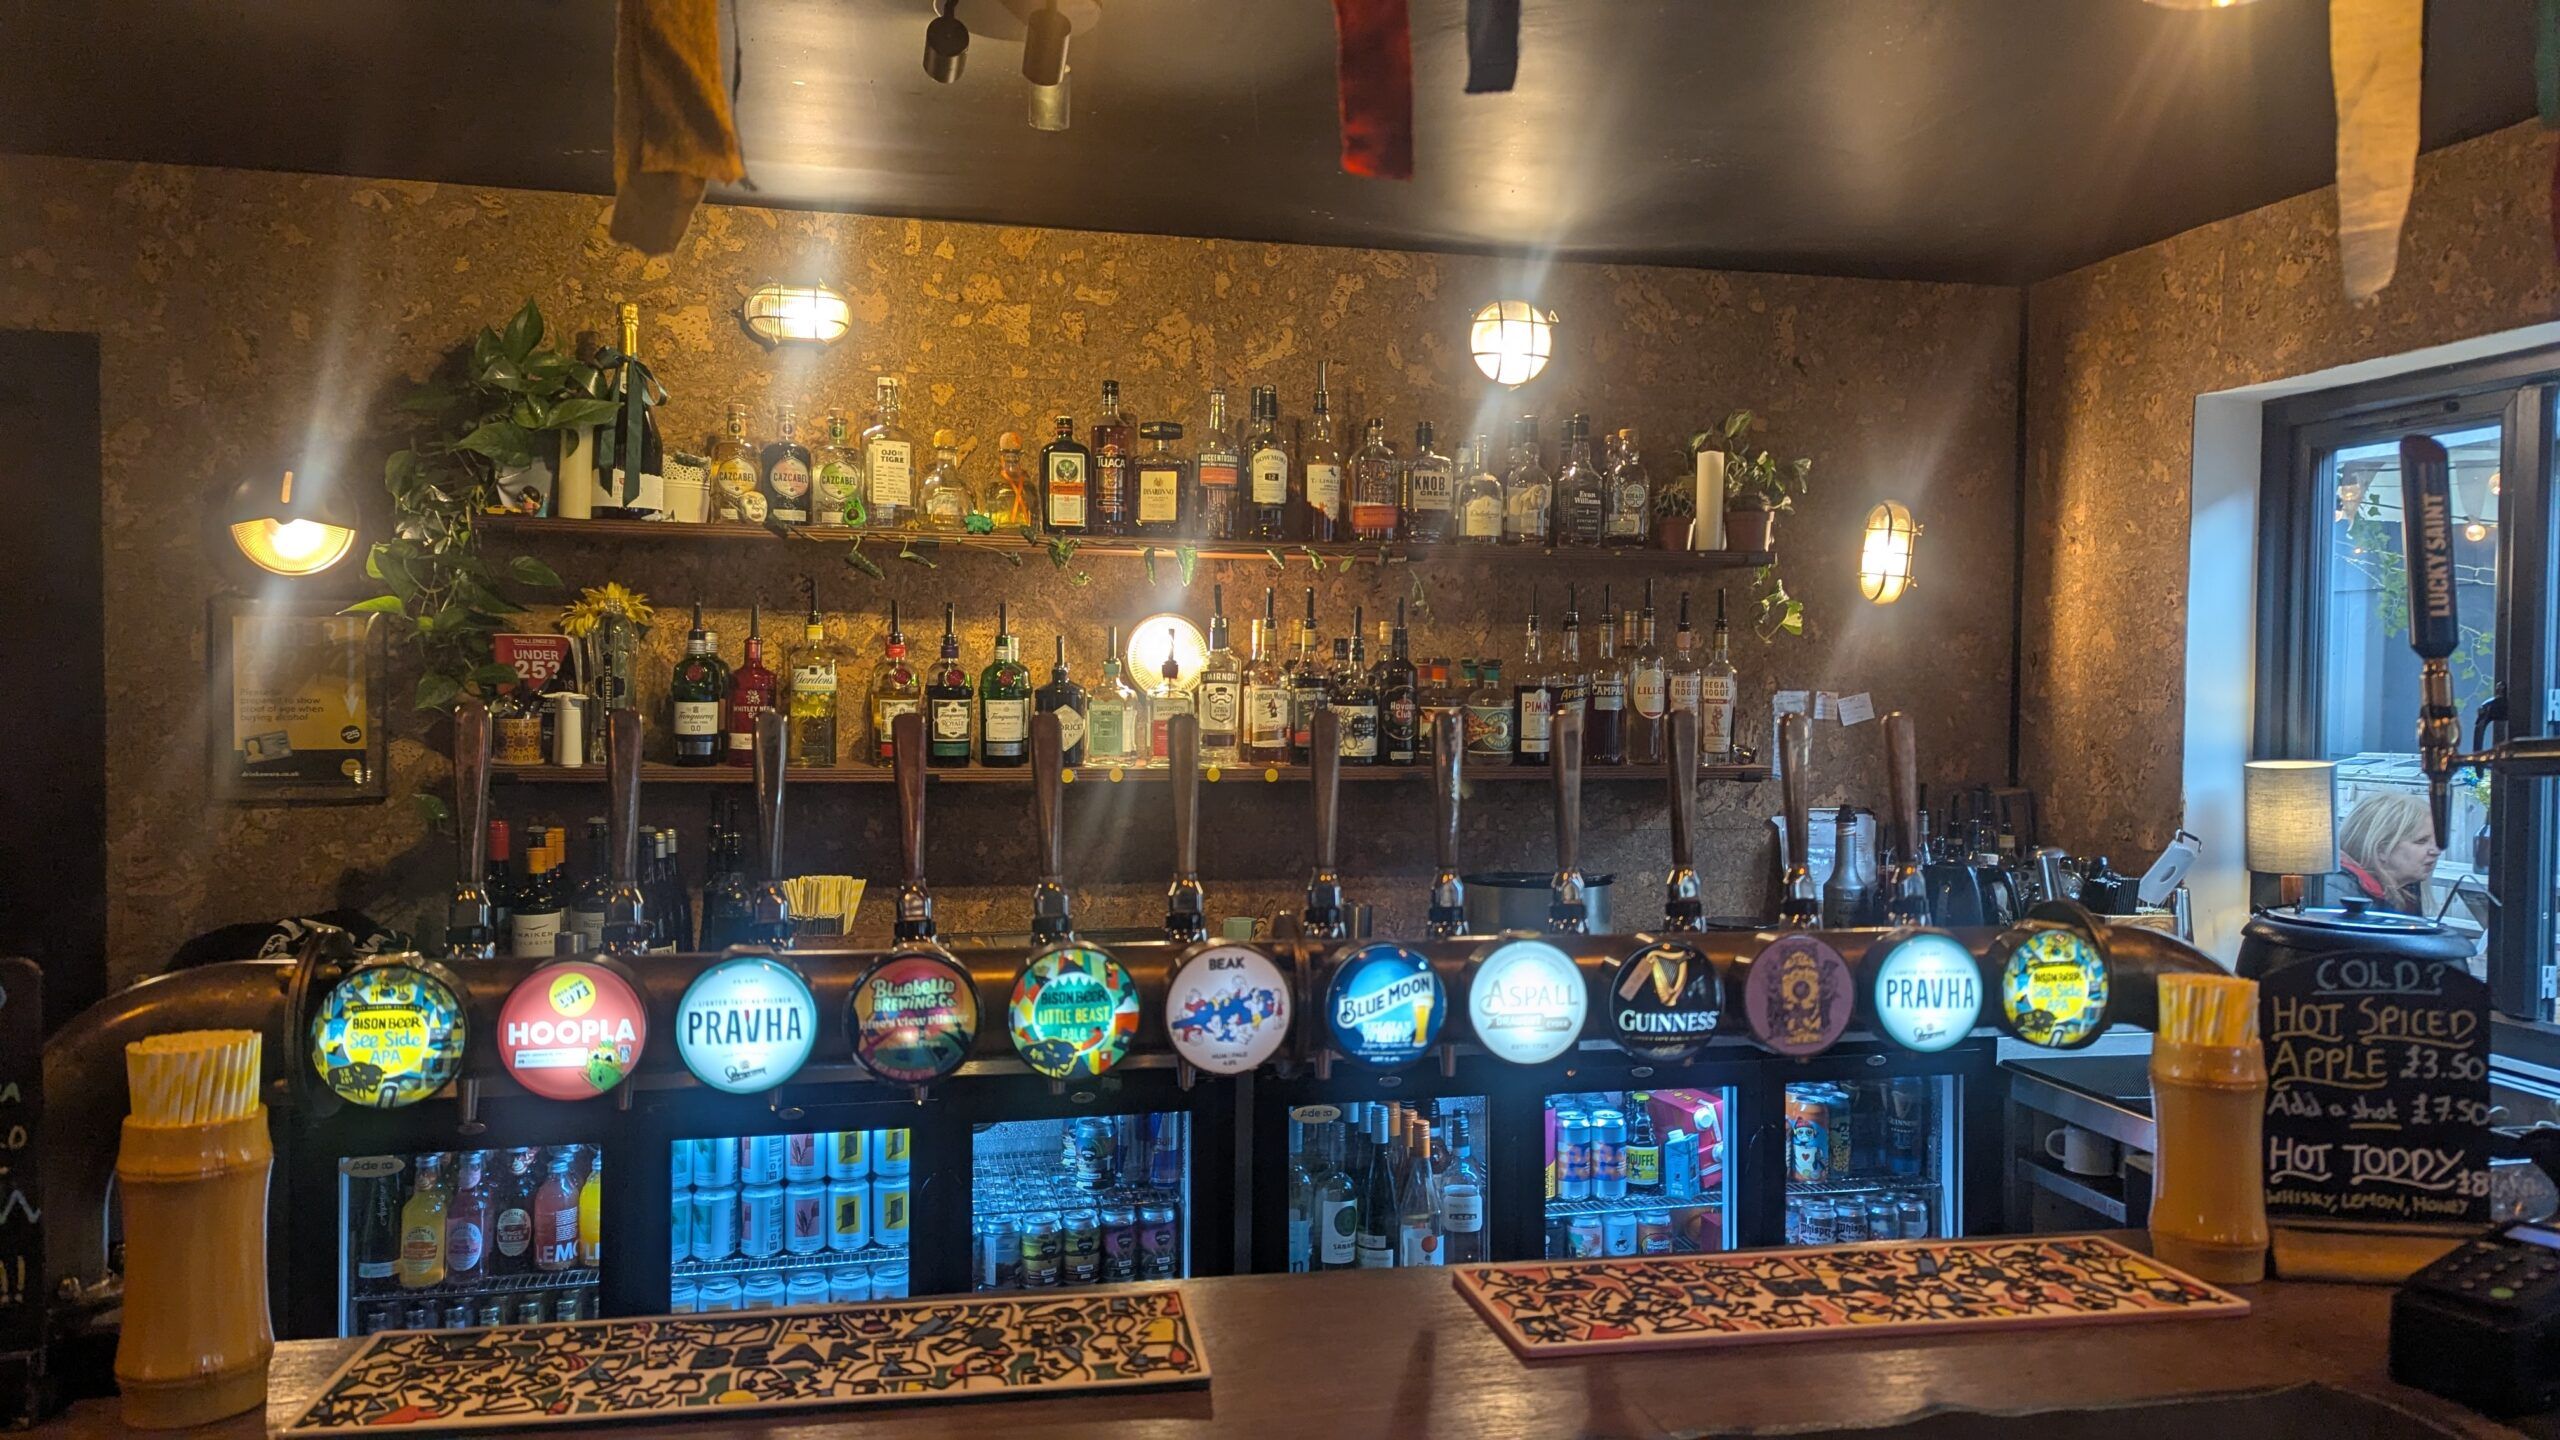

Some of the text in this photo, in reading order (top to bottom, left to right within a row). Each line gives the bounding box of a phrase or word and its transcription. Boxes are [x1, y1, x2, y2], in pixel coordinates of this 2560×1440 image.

[1096, 456, 1126, 468] TUACA
[719, 471, 756, 482] CAZCABEL
[773, 472, 808, 484] CAZCABEL
[822, 475, 857, 486] CAZCABEL
[1415, 475, 1446, 490] KNOB
[1579, 490, 1596, 498] Evan
[2423, 493, 2450, 618] LUCKY SAINT
[513, 650, 560, 660] UNDER
[514, 660, 560, 679] 25?
[1704, 681, 1730, 689] REGAL
[1704, 689, 1730, 697] ROGUE
[298, 705, 325, 713] when
[1396, 710, 1411, 718] Club
[1209, 957, 1245, 971] BEAK
[2315, 958, 2446, 991] COLD?
[871, 978, 955, 998] Bluebelle
[1886, 978, 1975, 1008] PRAVHA
[1041, 991, 1075, 1005] BISON
[1340, 977, 1431, 1024] BLUE MOON
[1480, 980, 1579, 1016] ASPALL
[353, 1018, 386, 1030] BISON
[1038, 1006, 1111, 1025] LITTLE BEAST
[1619, 1010, 1719, 1032] GUINNESS
[2272, 996, 2477, 1040] HOT SPICED
[508, 1018, 636, 1046] HOOPLA
[688, 1007, 802, 1045] PRAVHA
[350, 1030, 421, 1049] See Side
[369, 1050, 402, 1065] APA
[2271, 1040, 2487, 1081] APPLE £3.50
[2266, 1089, 2489, 1125] Add a shot £7.50
[2270, 1136, 2489, 1197] HOT TODDY £8
[2266, 1189, 2338, 1213] WHISKY,
[2341, 1193, 2411, 1216] LEMON,
[688, 1341, 871, 1369] BEAK
